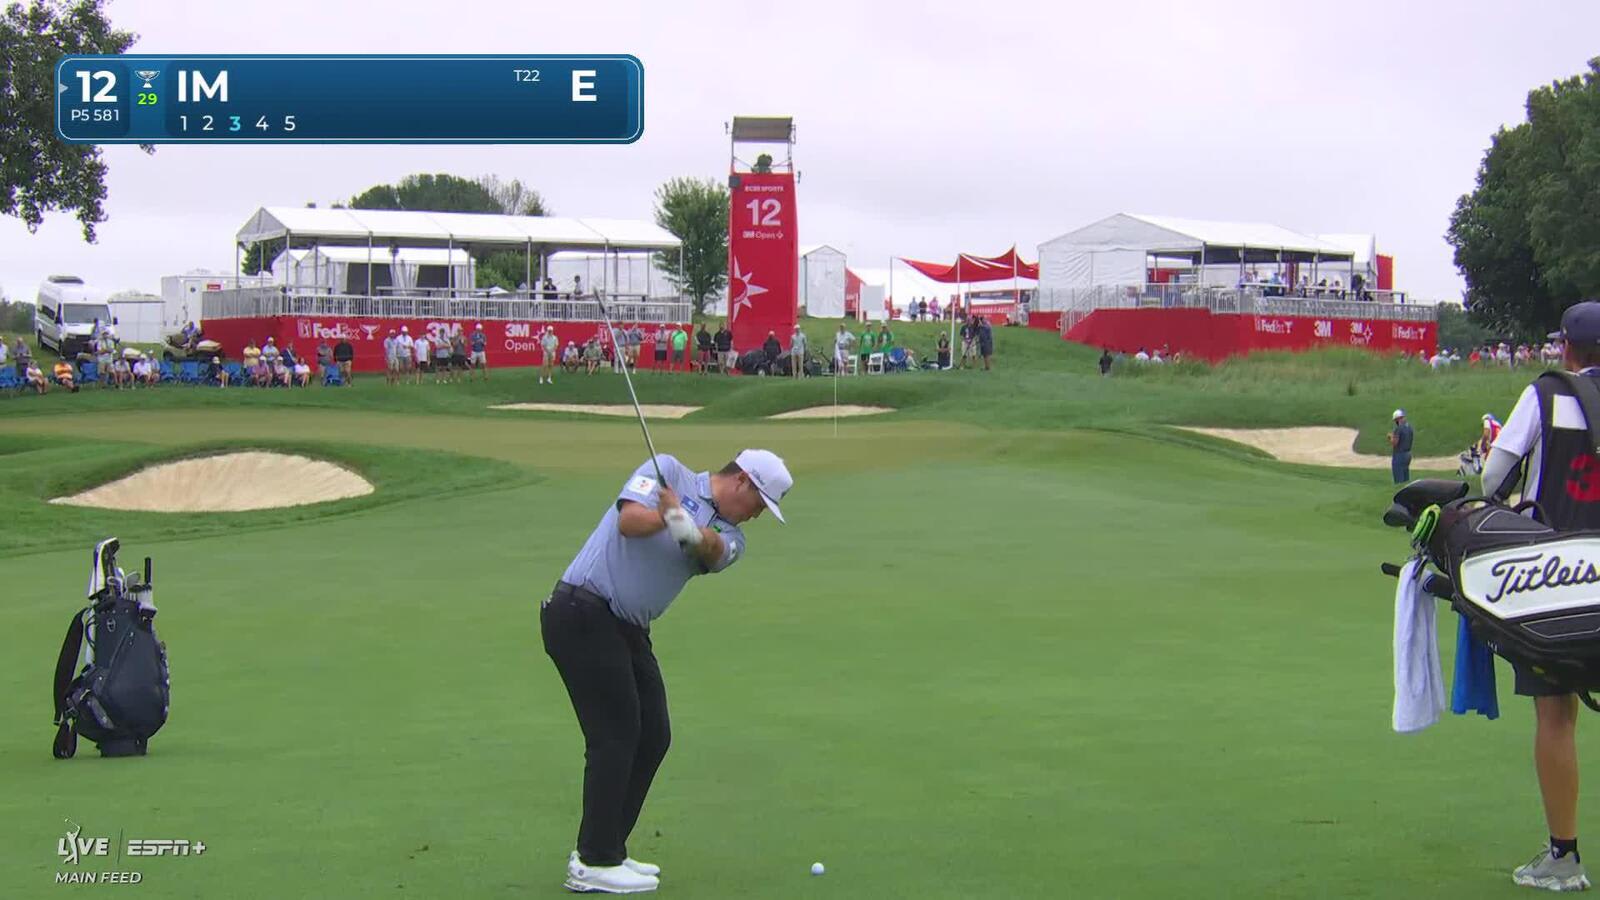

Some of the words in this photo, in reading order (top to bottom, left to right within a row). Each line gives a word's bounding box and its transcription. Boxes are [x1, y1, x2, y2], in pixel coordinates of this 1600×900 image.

[746, 199, 781, 226] 12
[755, 231, 776, 240] Open
[313, 322, 360, 340] FedEx
[504, 323, 530, 338] 3M
[1313, 320, 1332, 337] 3M
[1350, 322, 1363, 334] 3M
[504, 339, 536, 352] Open
